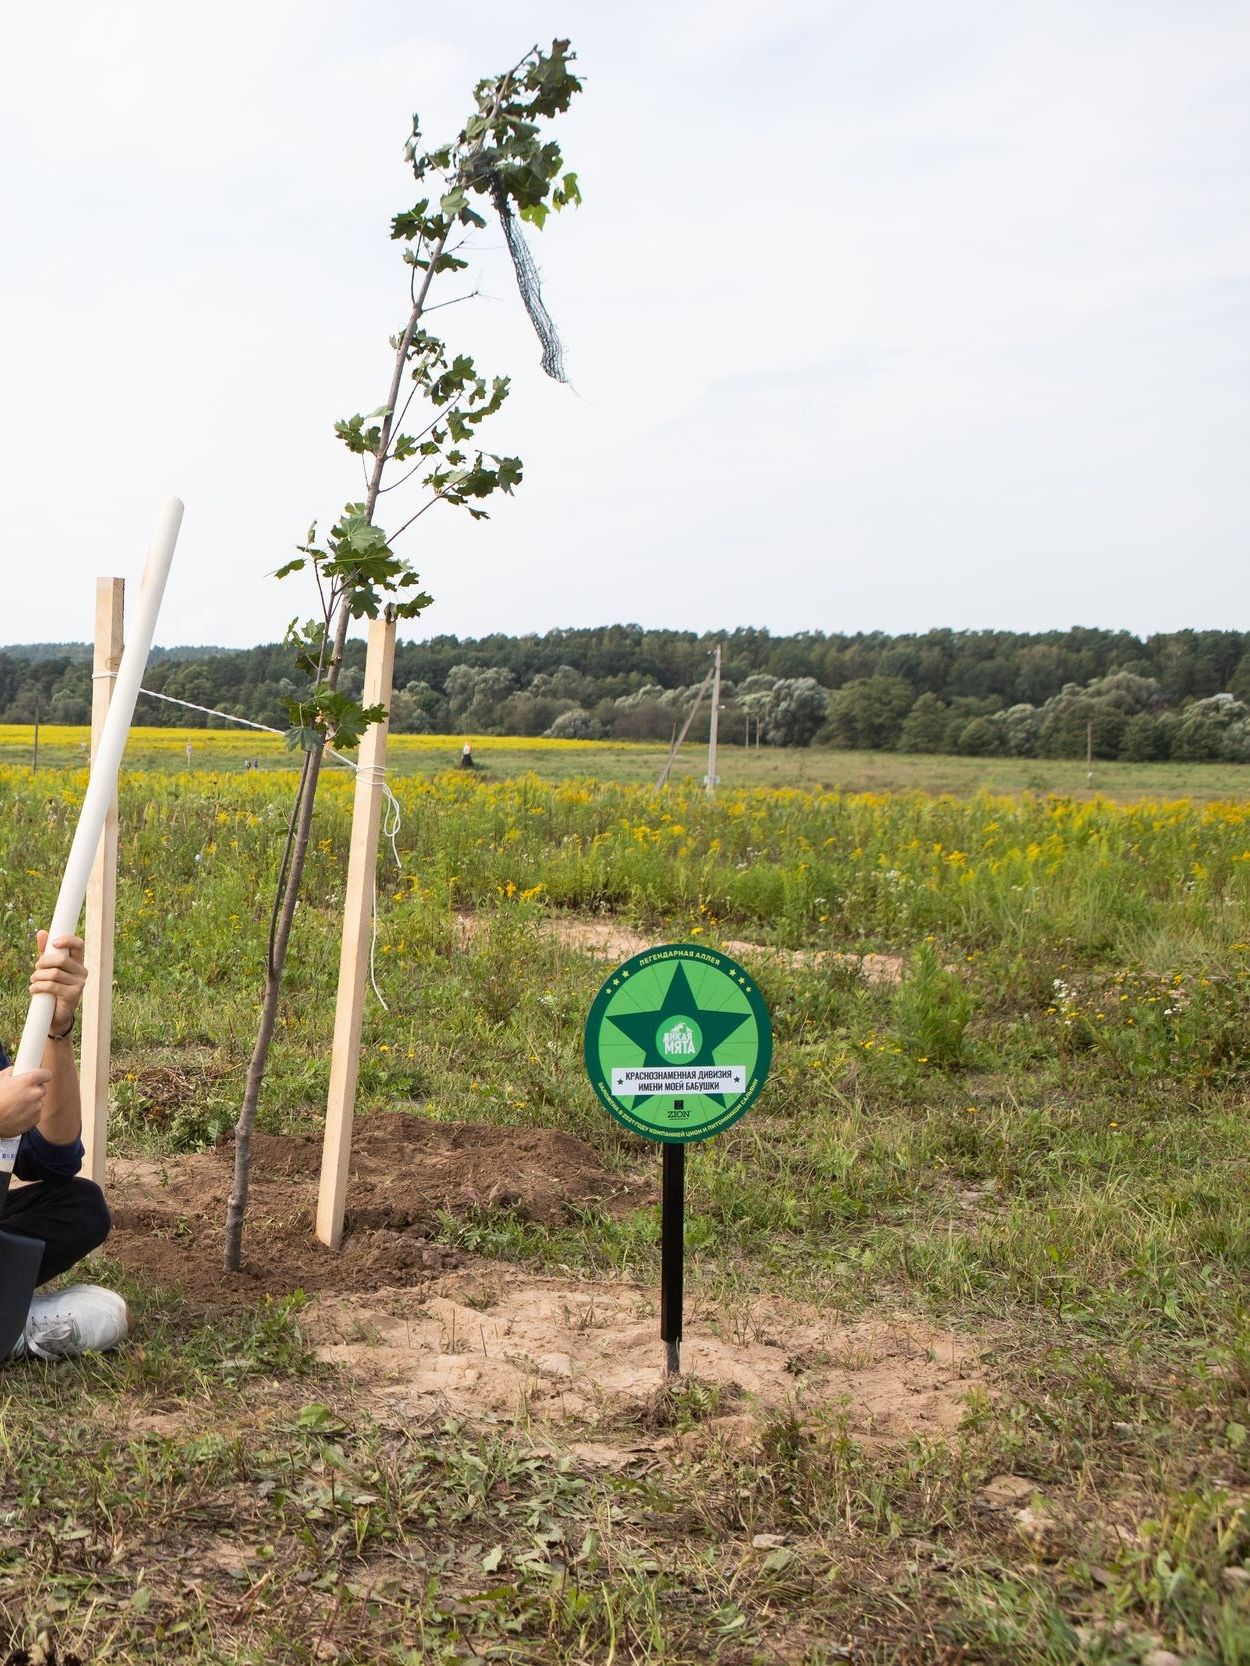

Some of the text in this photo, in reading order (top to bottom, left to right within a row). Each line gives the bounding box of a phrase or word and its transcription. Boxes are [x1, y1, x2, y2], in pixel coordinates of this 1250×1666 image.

[639, 950, 721, 967] ЛЕГЕНДАРНАЯ АЛЛЕЯ
[663, 1032, 693, 1042] ДИКАЯ
[664, 1040, 695, 1055] МЯТА
[625, 1070, 732, 1081] КРАСНОЗНАМЕННАЯ ДИВИЗИЯ
[638, 1080, 720, 1091] ИМЕНИ МОЕЙ БАБУШКИ
[667, 1111, 690, 1119] ZION
[621, 1112, 635, 1126] 2021
[634, 1121, 649, 1132] ГОДУ
[685, 1128, 703, 1138] ЦИОН
